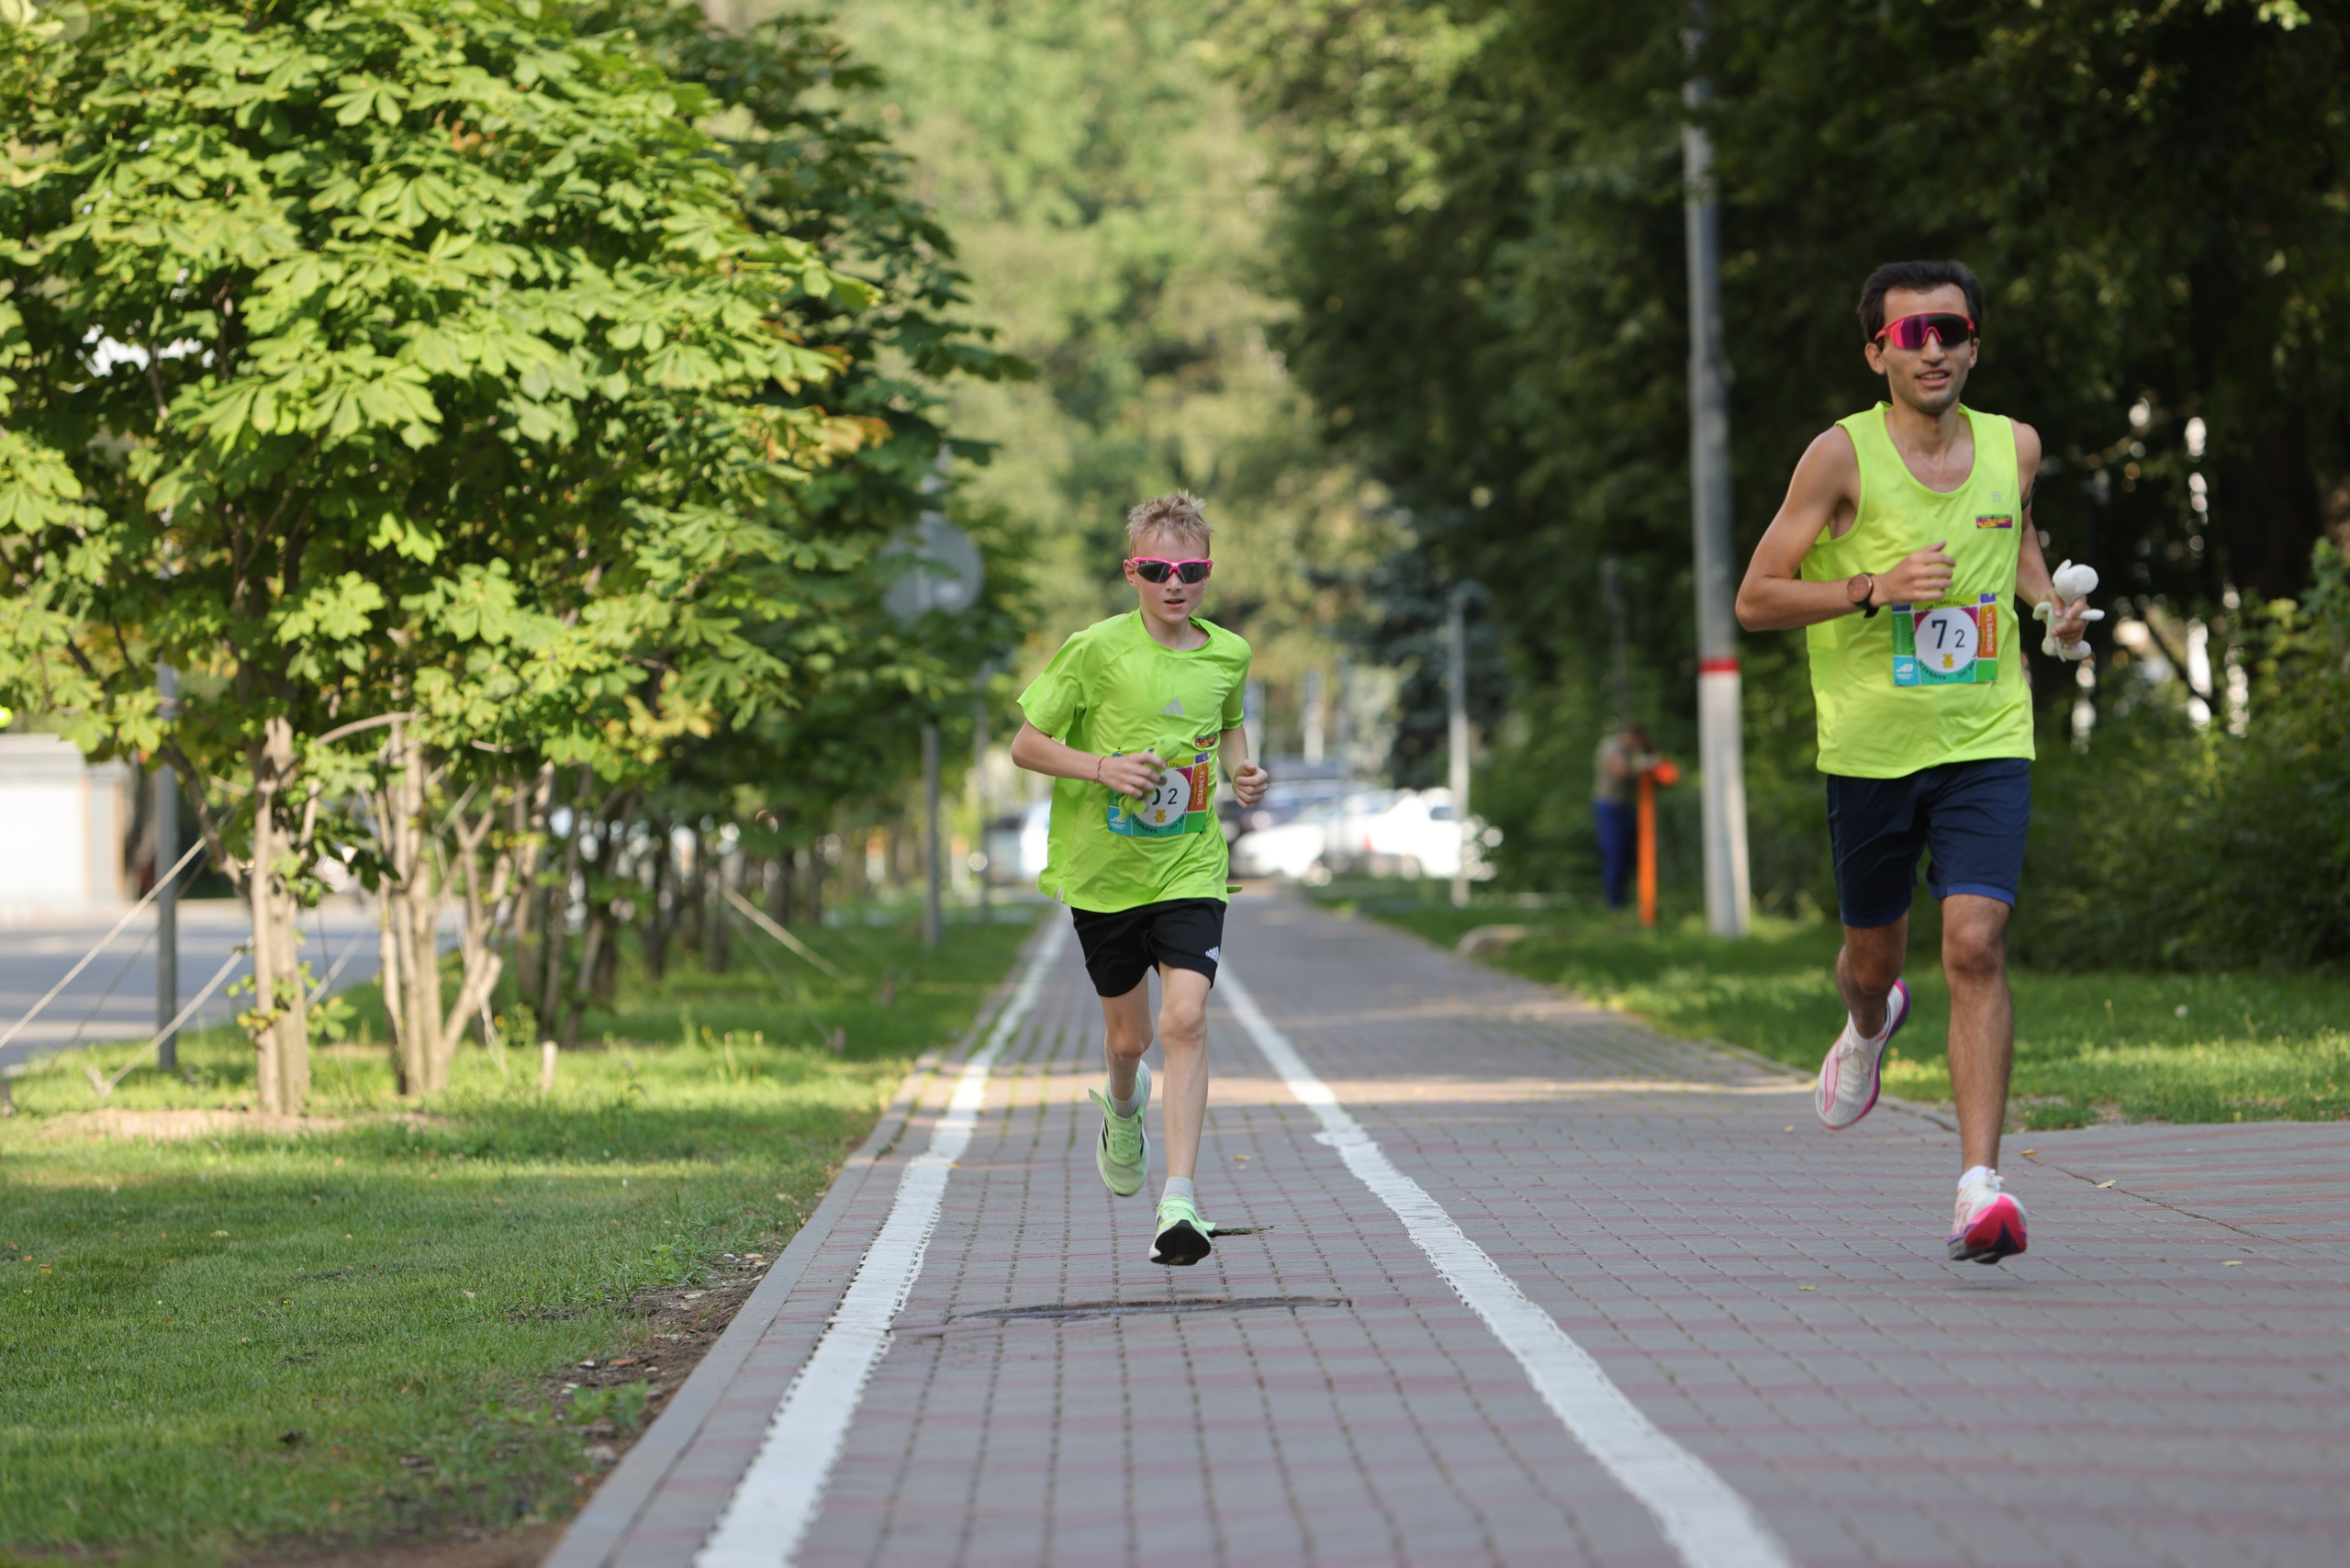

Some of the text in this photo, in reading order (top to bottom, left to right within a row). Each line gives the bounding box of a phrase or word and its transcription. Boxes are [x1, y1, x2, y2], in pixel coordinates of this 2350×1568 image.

[1931, 619, 1948, 649] 7
[1954, 629, 1965, 648] 2
[1986, 612, 1994, 653] ЭСТАФЕТА
[1168, 788, 1178, 805] 2
[1197, 770, 1205, 806] ЭСТАФЕТА
